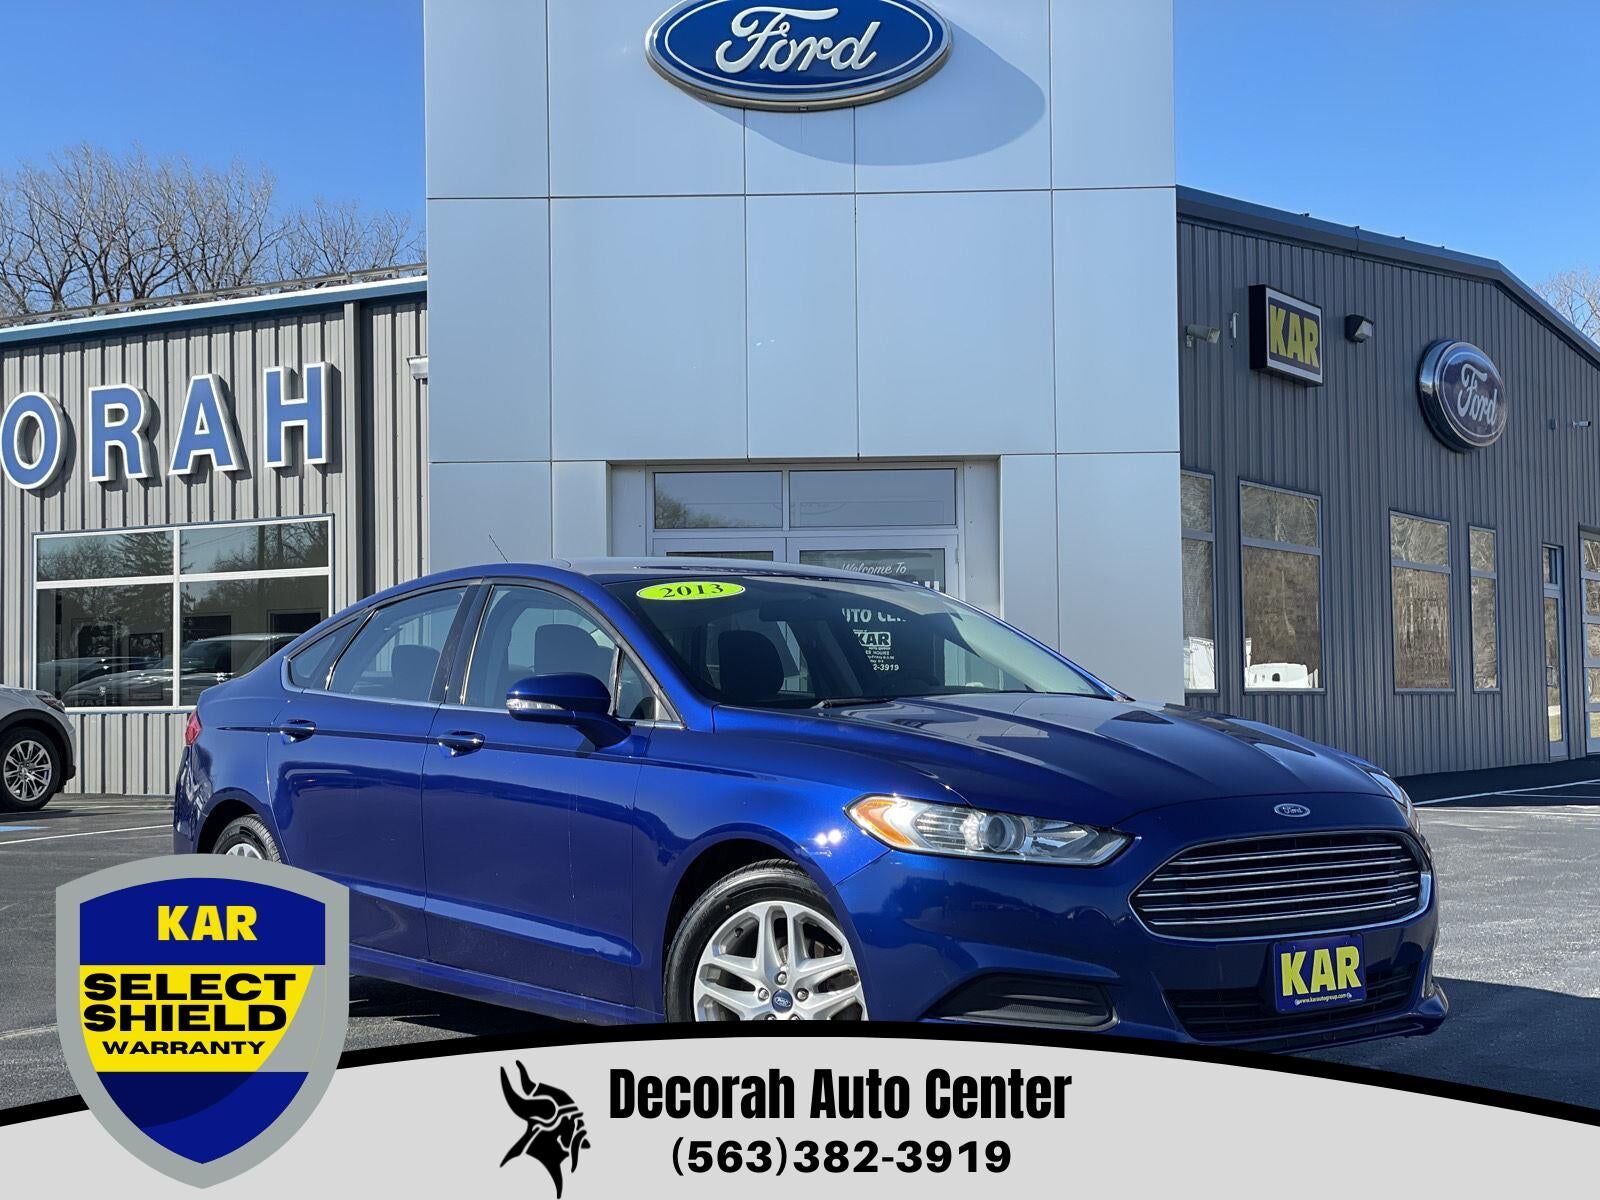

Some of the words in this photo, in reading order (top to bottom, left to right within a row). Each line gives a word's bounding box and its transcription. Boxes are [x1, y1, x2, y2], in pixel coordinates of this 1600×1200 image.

[715, 6, 881, 73] Ford
[1269, 304, 1320, 369] KAR
[0, 361, 333, 489] ORAH
[1457, 363, 1498, 426] Ford
[659, 584, 724, 598] 2013
[842, 561, 892, 575] Welcome
[895, 561, 907, 574] To
[1280, 945, 1362, 997] KAR
